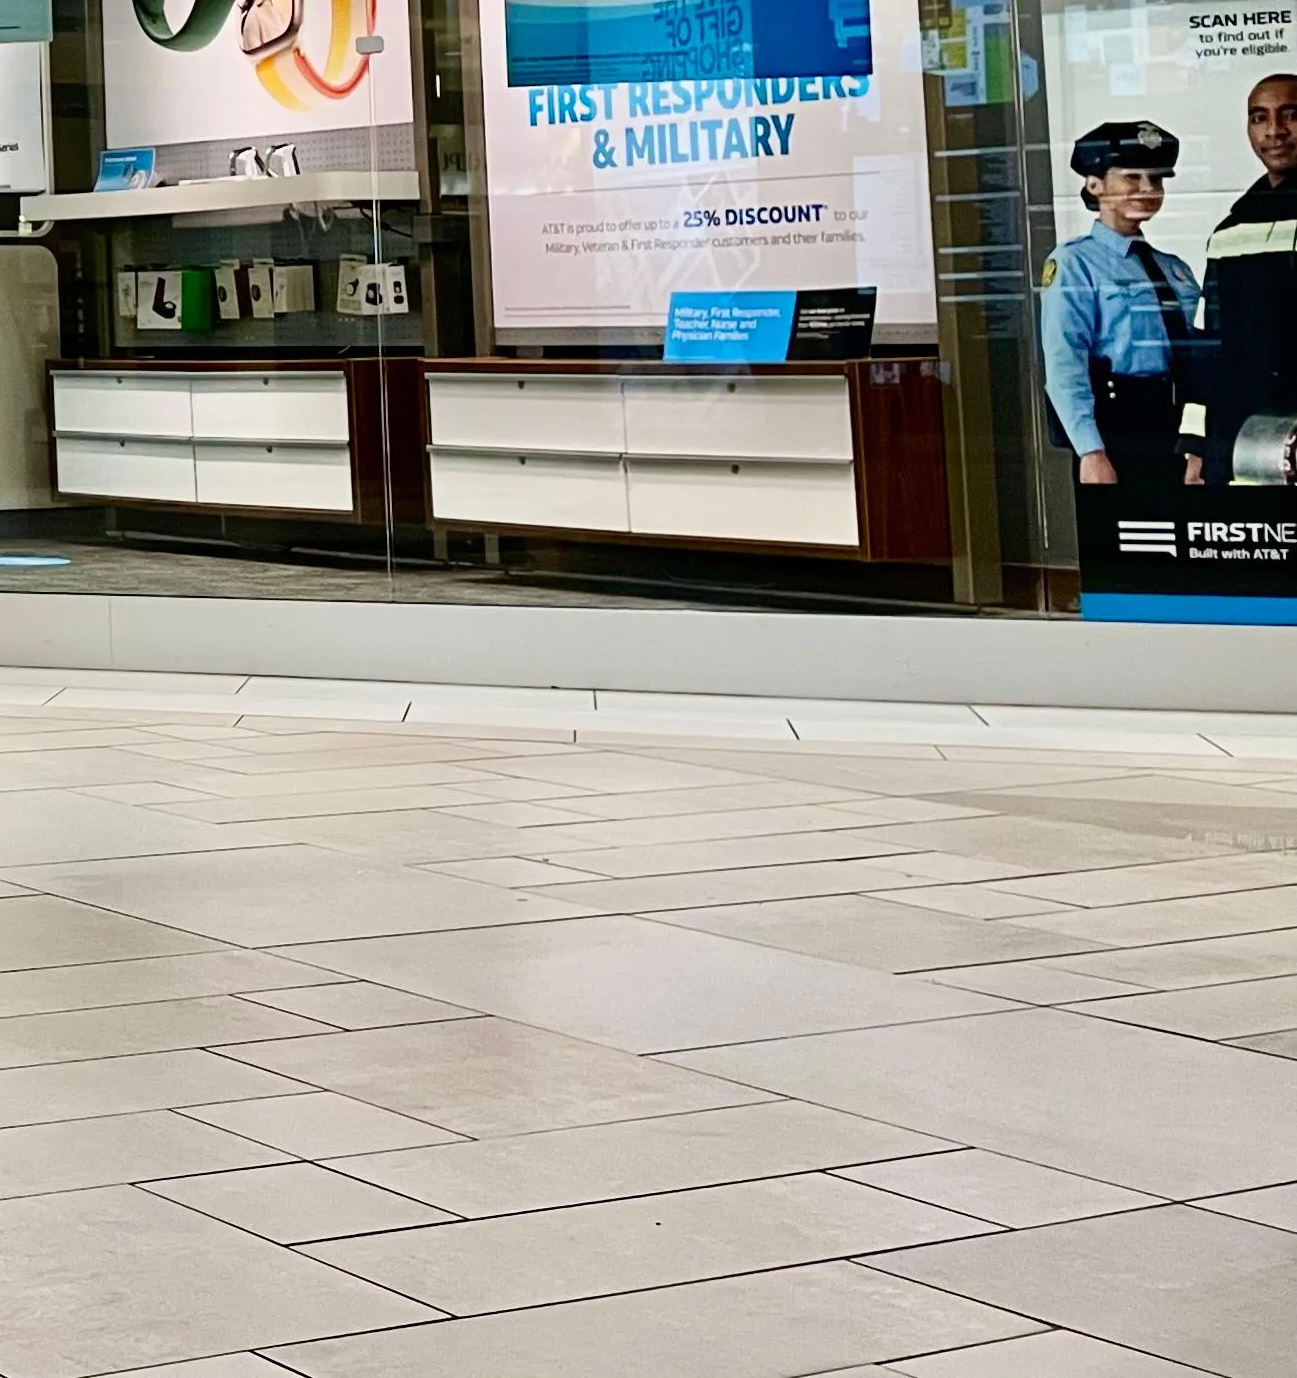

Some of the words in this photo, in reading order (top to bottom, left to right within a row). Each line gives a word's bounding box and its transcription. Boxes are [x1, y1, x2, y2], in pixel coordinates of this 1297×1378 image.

[1189, 14, 1237, 29] SCAN
[1243, 10, 1292, 26] HERE
[1199, 34, 1213, 43] to
[1218, 31, 1244, 42] find
[1248, 30, 1270, 41] out
[1275, 28, 1284, 39] if
[1196, 45, 1237, 59] you're
[1242, 42, 1291, 56] eligible.
[528, 85, 617, 126] FIRST
[628, 74, 870, 118] RESPONDERS
[592, 129, 617, 169] &
[625, 113, 795, 167] MILITARY
[542, 223, 566, 235] AT&T
[567, 223, 574, 234] is
[576, 219, 604, 235] proud
[605, 221, 617, 232] to
[644, 220, 657, 232] up
[683, 210, 721, 228] 25%
[834, 210, 846, 221] to
[712, 234, 769, 248] customers
[771, 233, 791, 245] and
[1187, 522, 1297, 543] FIRSTNE
[1189, 547, 1218, 559] Built
[1221, 548, 1251, 559] with
[1253, 548, 1289, 560] AT&T
